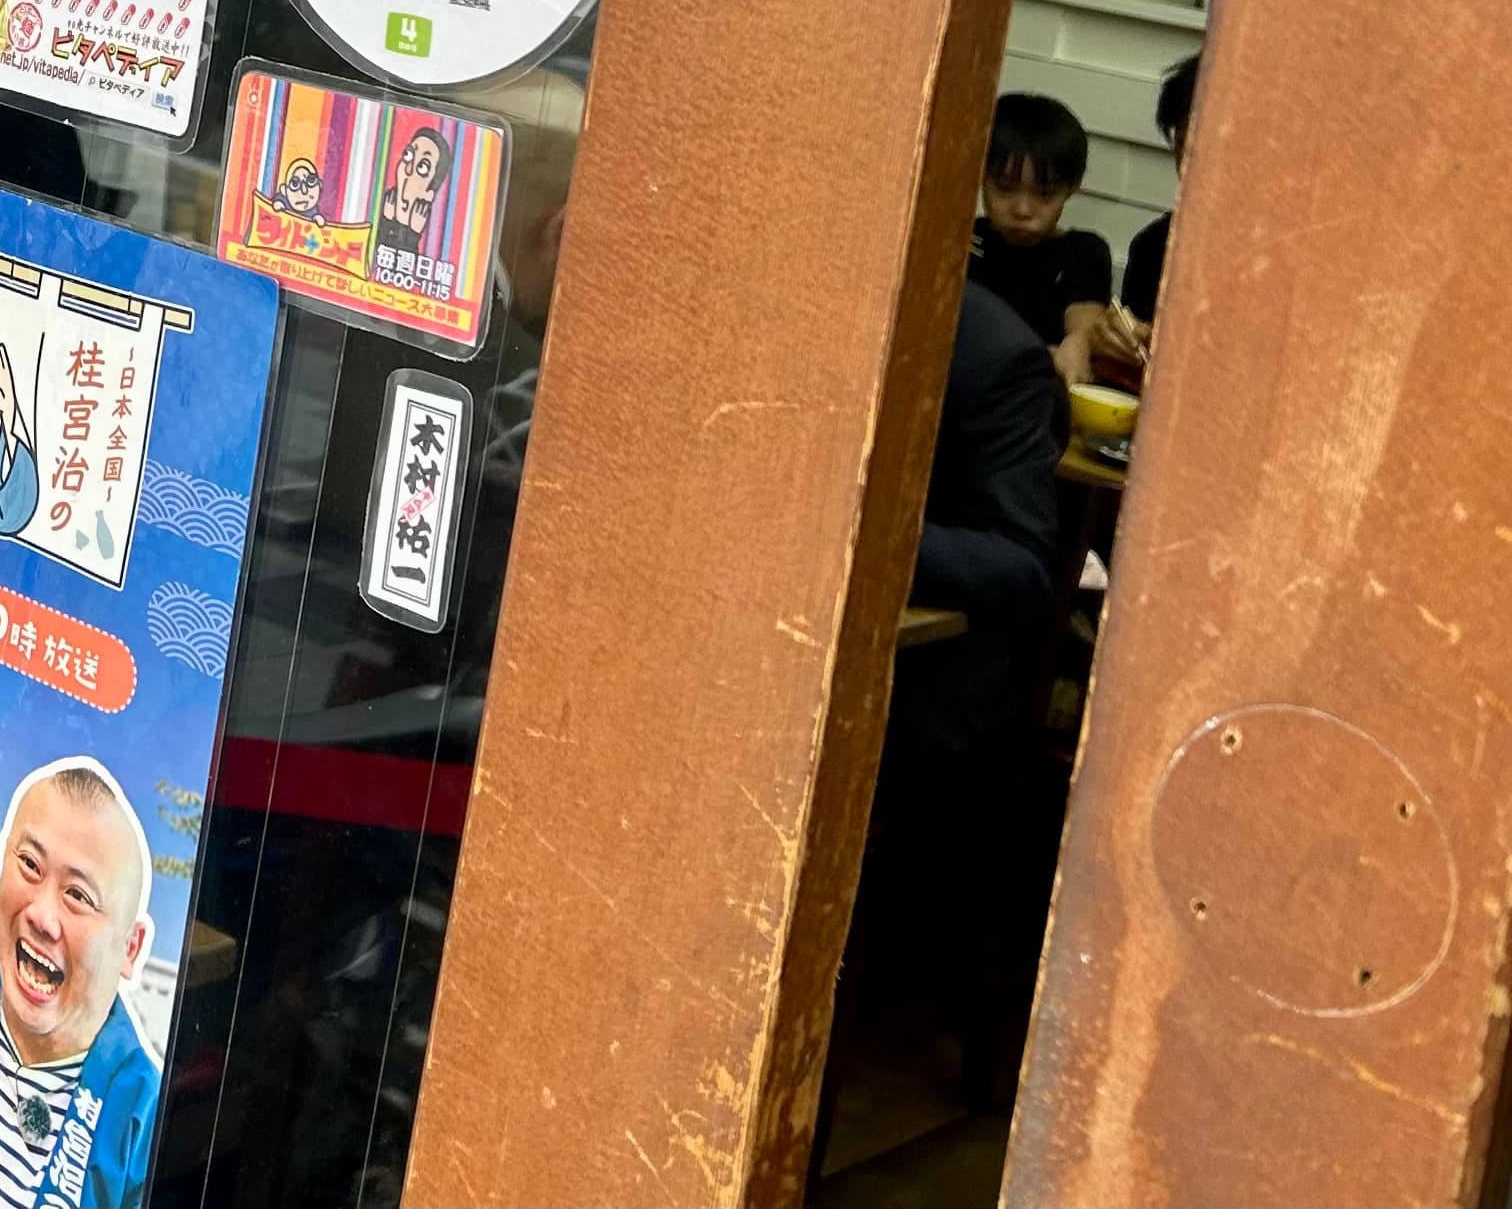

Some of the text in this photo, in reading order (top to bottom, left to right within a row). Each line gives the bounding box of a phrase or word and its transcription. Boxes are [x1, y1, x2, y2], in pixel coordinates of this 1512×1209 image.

[376, 244, 455, 287] 毎週日曜
[49, 341, 108, 532] 桂宮治の
